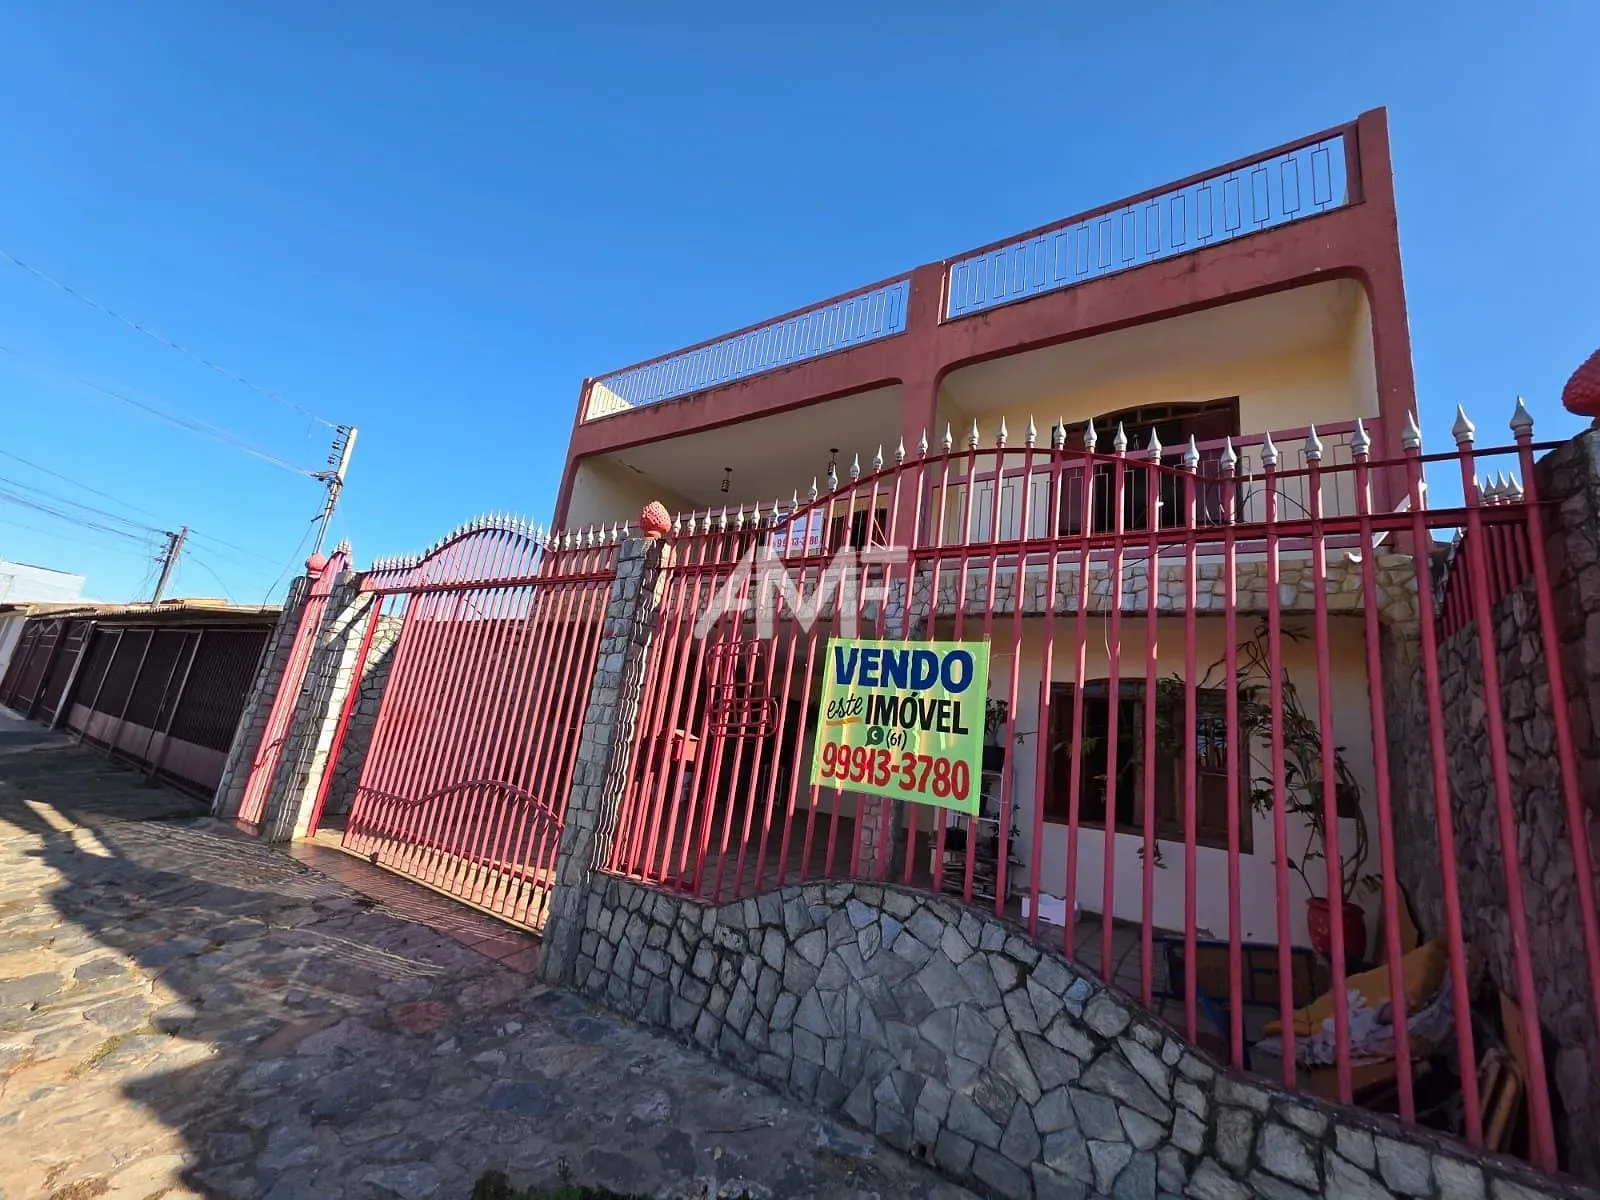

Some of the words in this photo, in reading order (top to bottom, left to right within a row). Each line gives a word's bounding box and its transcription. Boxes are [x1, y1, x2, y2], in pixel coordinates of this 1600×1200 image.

[834, 646, 974, 693] VENDO
[827, 693, 863, 719] este
[865, 692, 969, 735] IMÓVEL
[886, 729, 908, 751] (61)
[821, 741, 970, 801] 99913-3780
